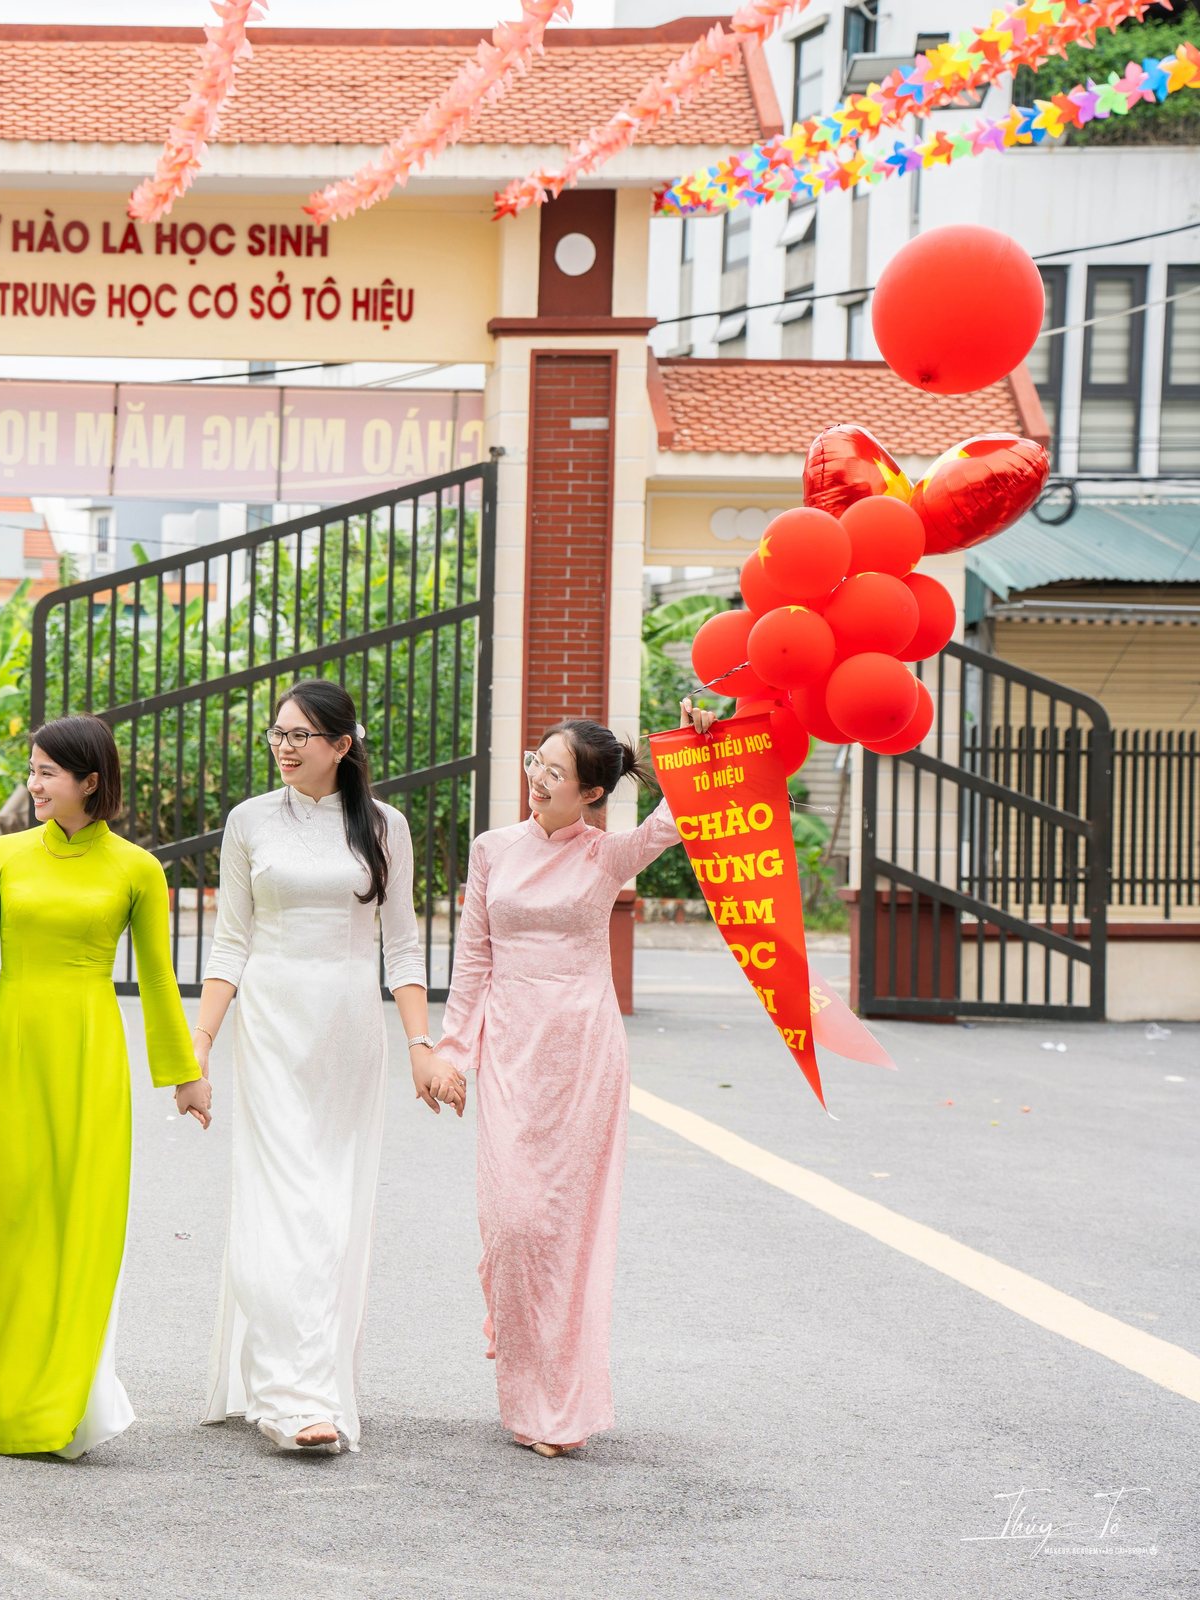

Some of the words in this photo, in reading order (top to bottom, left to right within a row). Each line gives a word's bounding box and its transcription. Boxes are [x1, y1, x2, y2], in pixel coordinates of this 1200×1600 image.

[12, 209, 90, 254] HÀO
[155, 222, 235, 265] HỌC
[247, 223, 329, 257] SINH
[107, 284, 177, 326] HỌC
[188, 283, 238, 319] CƠ
[249, 270, 292, 320] SỞ
[302, 277, 341, 322] TÔ
[352, 278, 414, 331] HIỆU
[656, 746, 711, 770] TRƯỜNG
[712, 734, 743, 759] TIỂU
[745, 733, 772, 754] HỌC
[693, 771, 710, 792] TÔ
[712, 765, 744, 788] HIỆU
[676, 800, 774, 841] CHÀO
